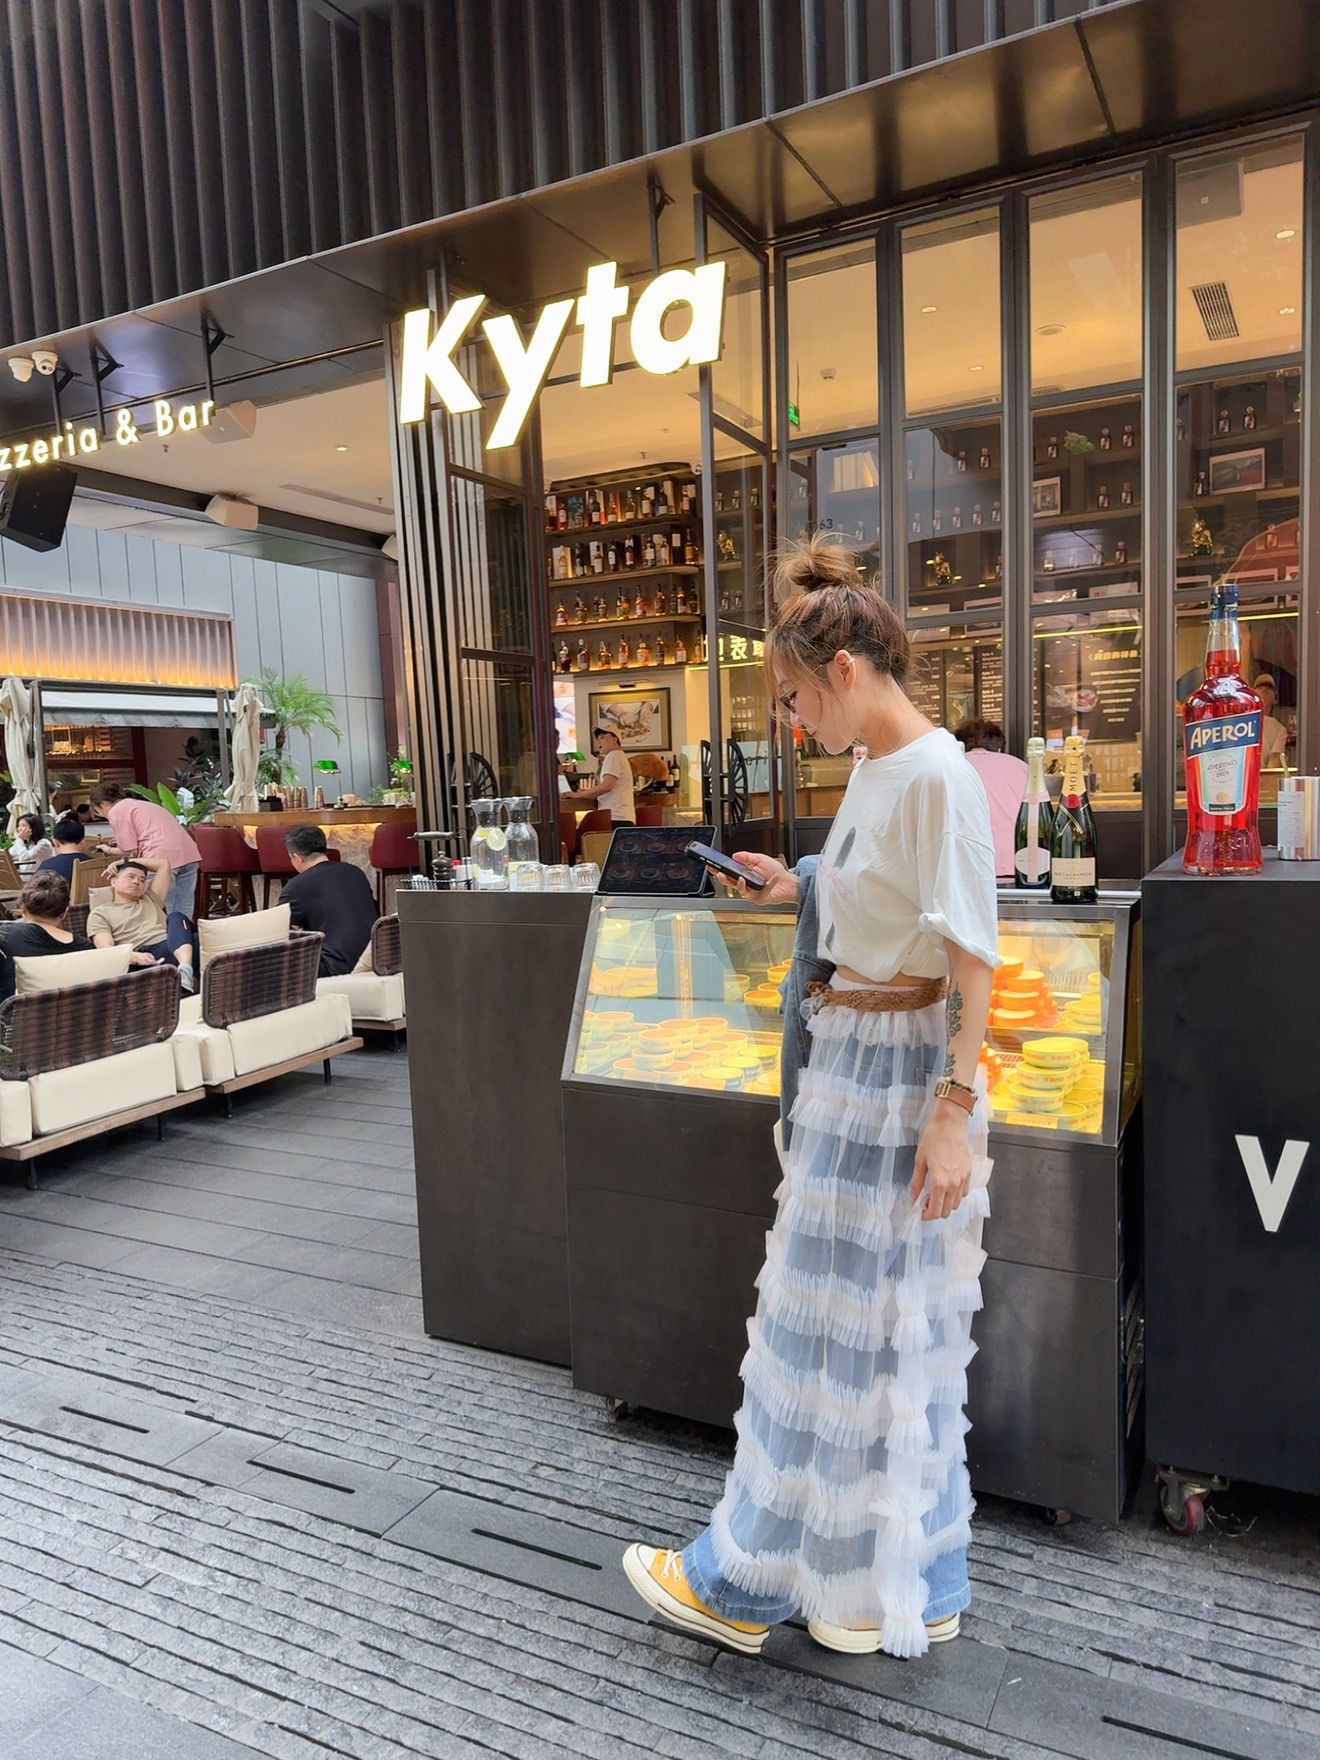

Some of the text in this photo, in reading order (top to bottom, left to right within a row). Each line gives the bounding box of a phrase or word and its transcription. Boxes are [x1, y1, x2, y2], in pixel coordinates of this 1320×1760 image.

[400, 261, 727, 450] Kyta
[116, 408, 139, 446] &
[155, 399, 215, 437] Bar
[1190, 721, 1255, 750] APEROL
[1235, 1134, 1310, 1232] V
